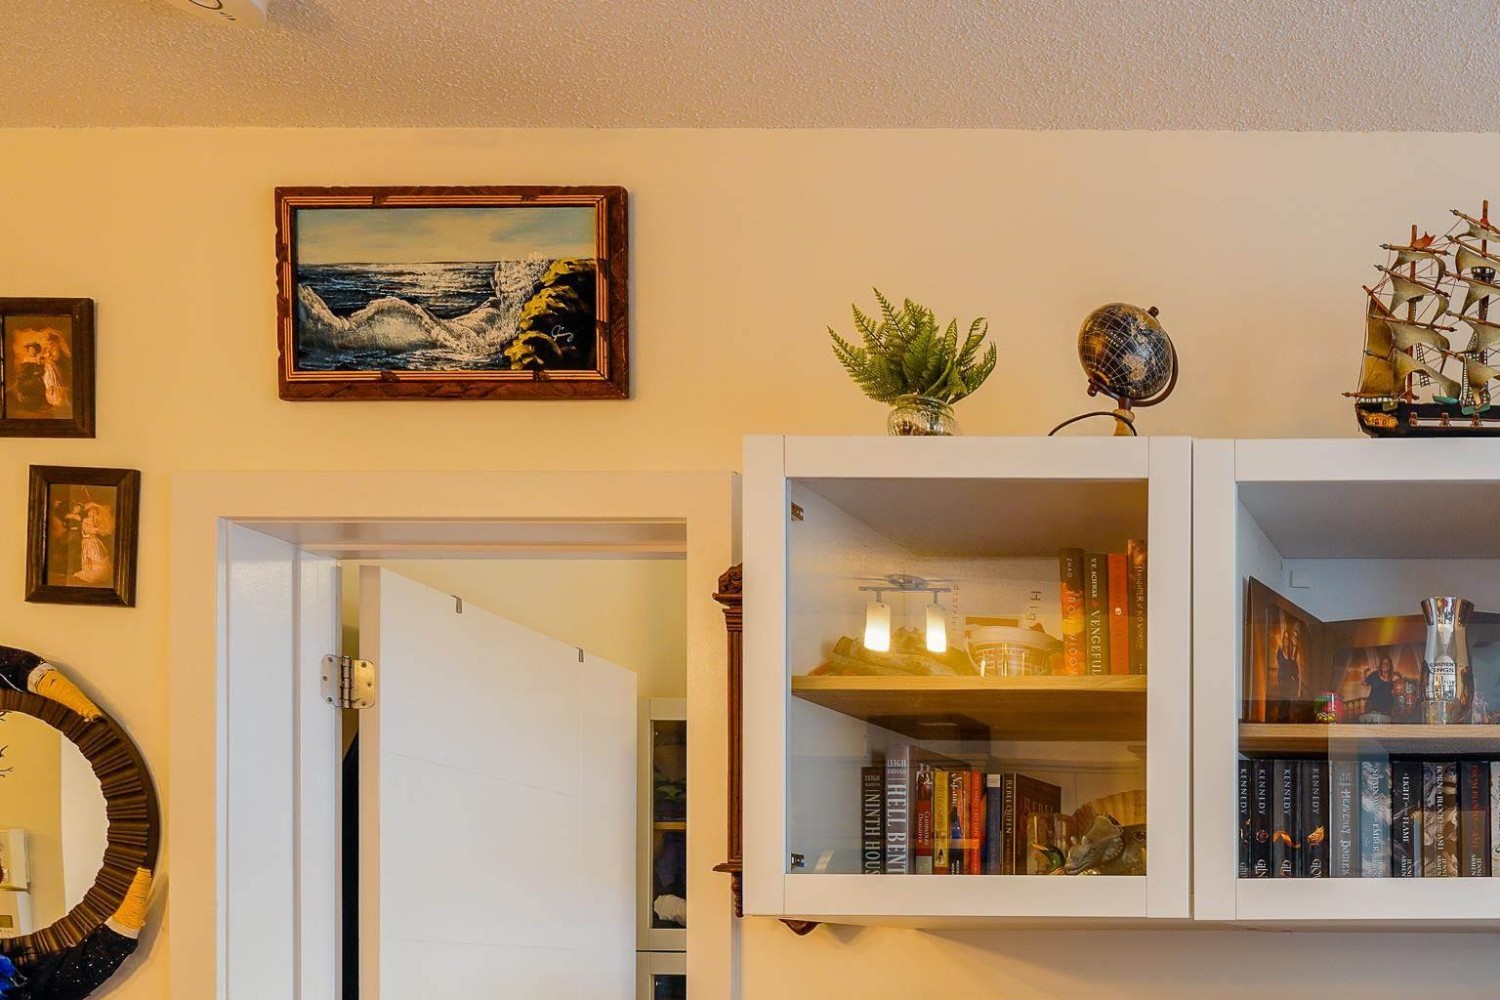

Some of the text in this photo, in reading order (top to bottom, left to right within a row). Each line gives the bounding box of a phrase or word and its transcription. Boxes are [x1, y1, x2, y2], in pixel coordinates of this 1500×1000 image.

[1258, 769, 1266, 815] KENNEDY
[1312, 768, 1320, 815] KENNEDY
[865, 792, 881, 874] NINTH HOUS
[887, 784, 907, 875] HELL BENT
